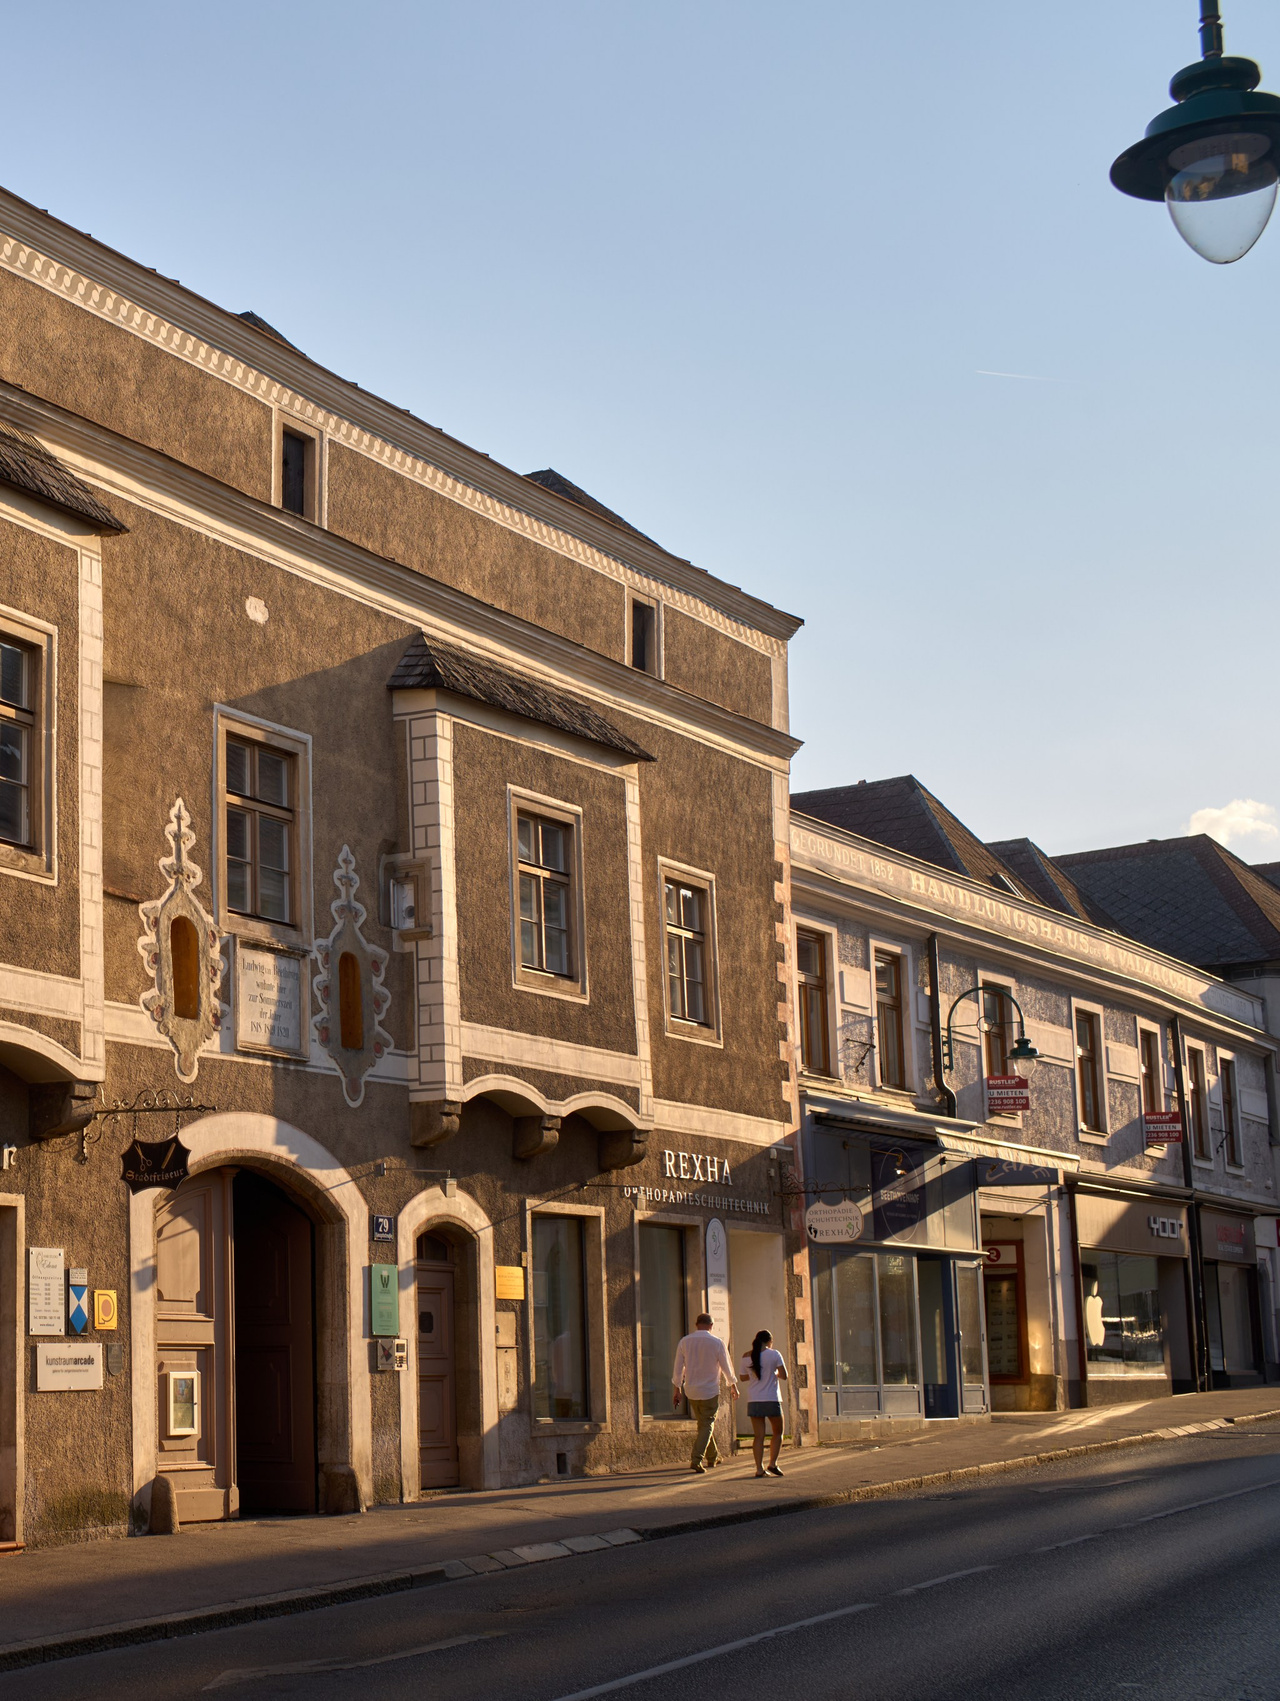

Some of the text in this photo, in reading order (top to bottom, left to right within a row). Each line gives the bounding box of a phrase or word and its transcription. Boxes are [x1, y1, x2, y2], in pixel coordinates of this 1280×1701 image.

[870, 859, 894, 881] 1852
[910, 871, 1090, 954] HANDLUNGSHAUS
[242, 958, 265, 976] Ludwig
[273, 964, 299, 981] Beethoven
[256, 980, 287, 994] wohnte hier
[248, 992, 293, 1010] zur Sommerszeit
[260, 1008, 268, 1019] der
[664, 1149, 733, 1186] REXHA
[125, 1168, 184, 1183] Stadtfriseur
[378, 1218, 389, 1233] 79
[807, 1215, 860, 1224] SCHUHTECHNIK
[819, 1228, 850, 1237] REXHA
[45, 1355, 95, 1366] kunstraumarcade
